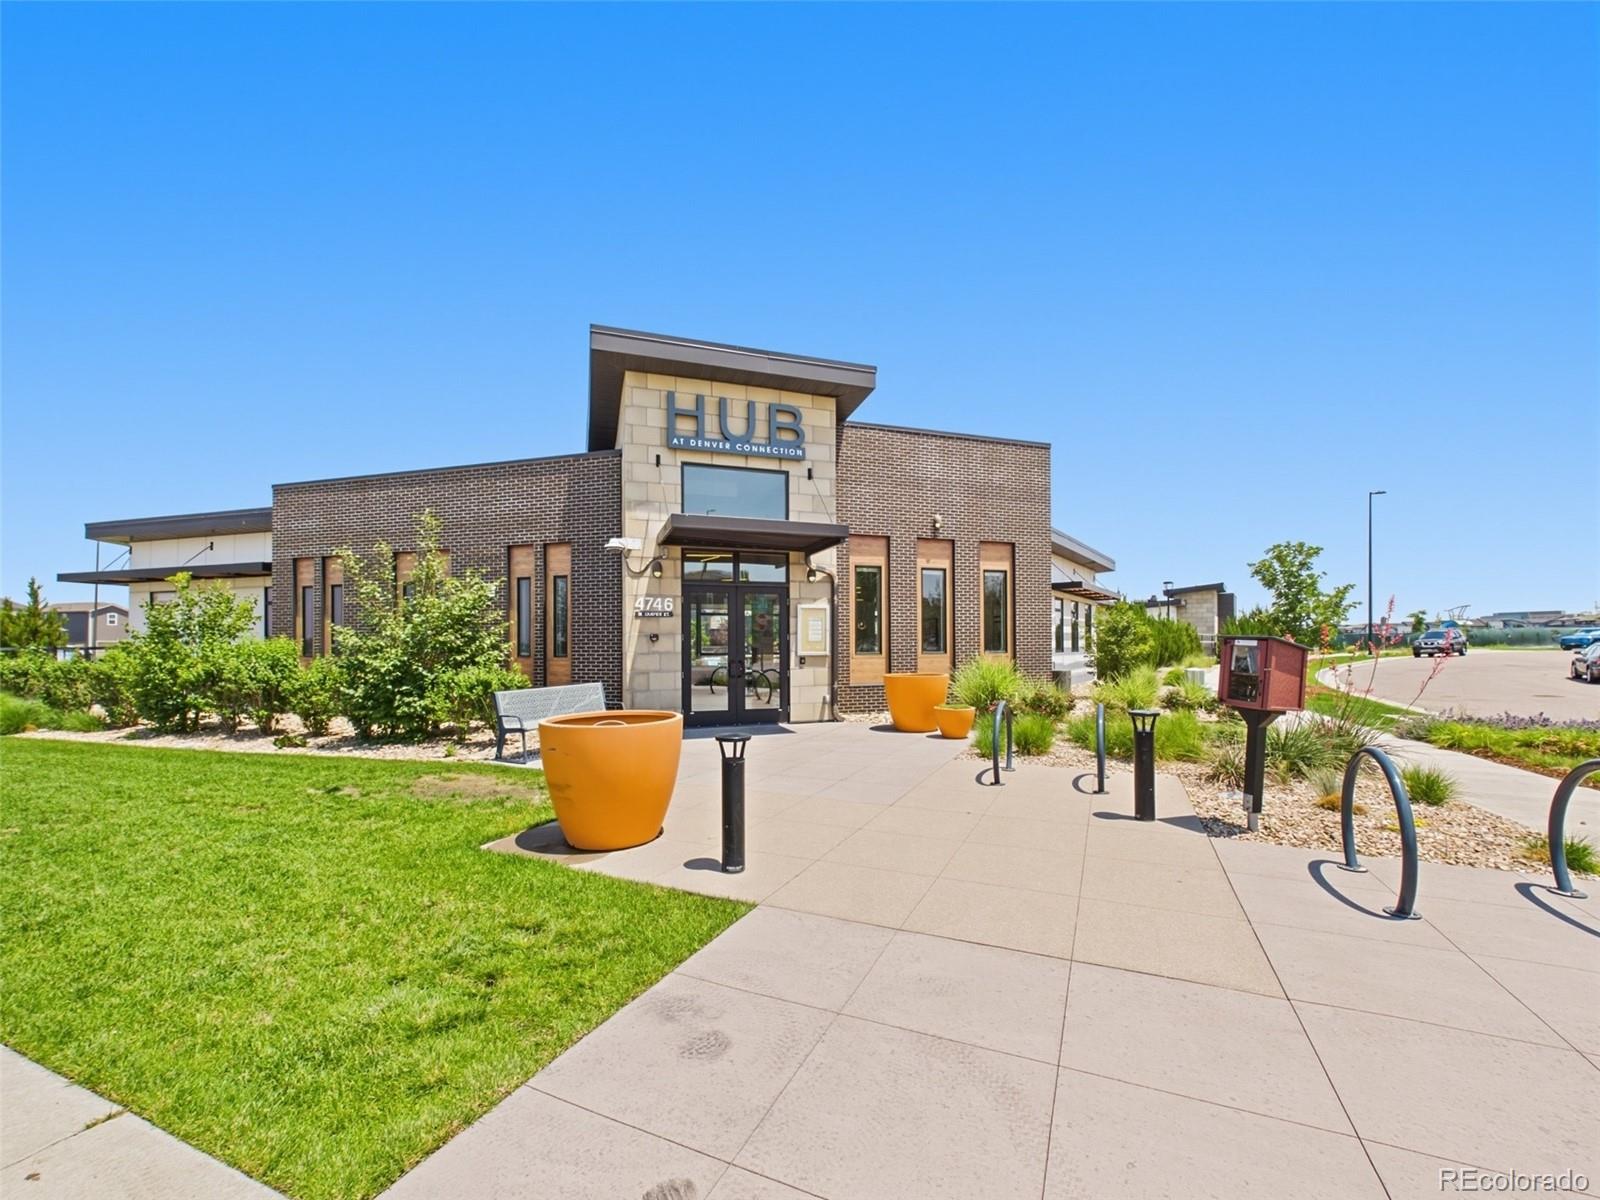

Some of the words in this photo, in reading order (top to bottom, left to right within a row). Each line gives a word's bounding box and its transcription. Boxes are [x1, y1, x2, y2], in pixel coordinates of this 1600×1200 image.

[667, 391, 805, 447] HUB
[672, 438, 685, 446] AT
[690, 439, 731, 450] DENVER
[735, 443, 803, 457] CONNECTION
[634, 597, 673, 612] 4746
